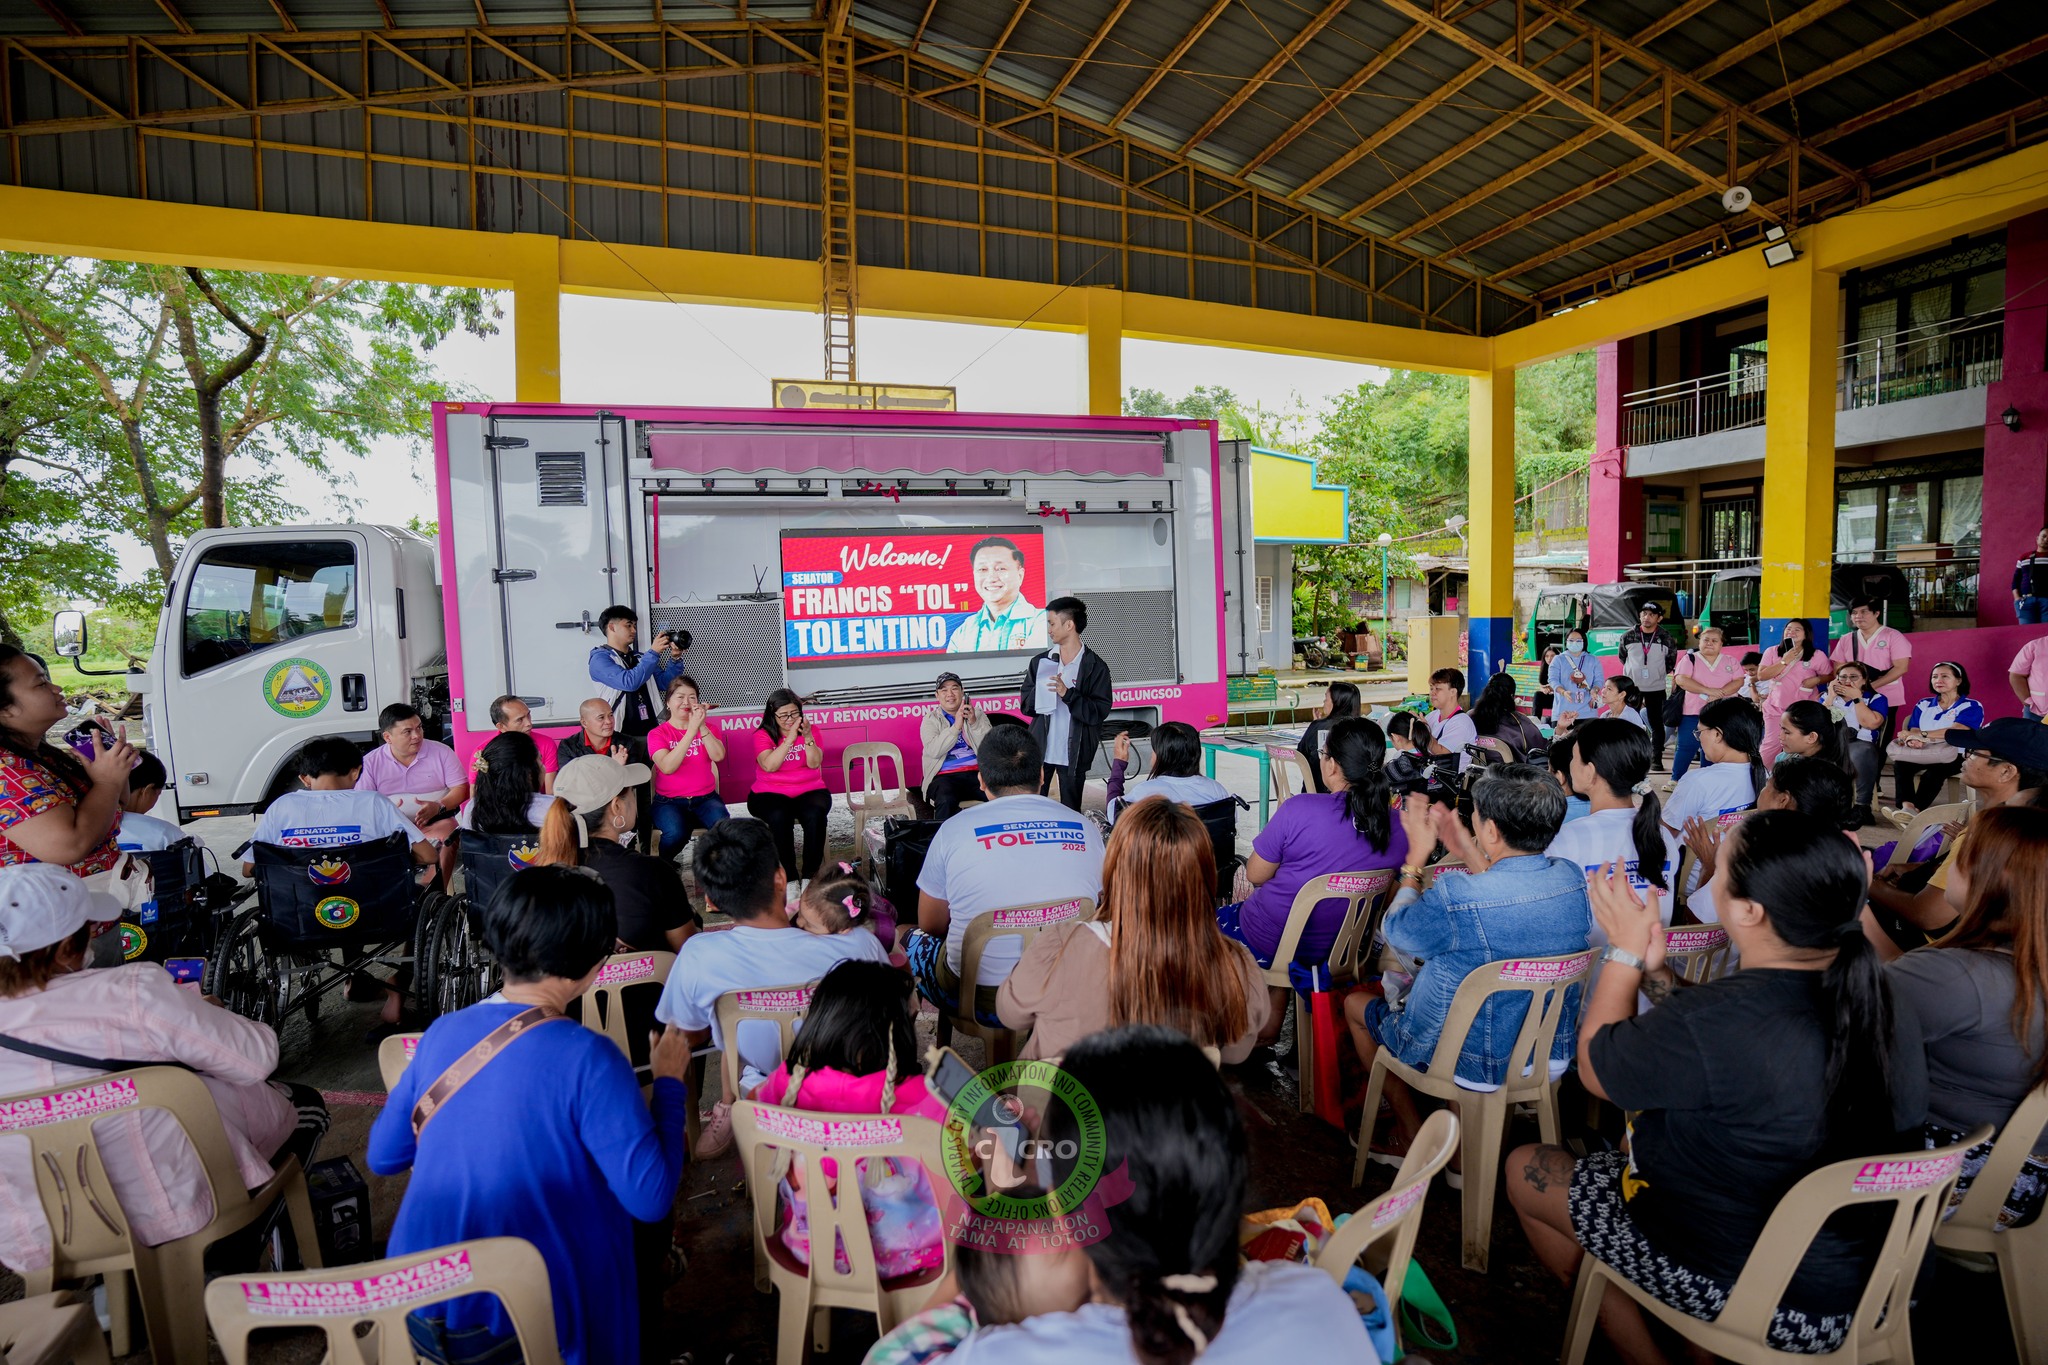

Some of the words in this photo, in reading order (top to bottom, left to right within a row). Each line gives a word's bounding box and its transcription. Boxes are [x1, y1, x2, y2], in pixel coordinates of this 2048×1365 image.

[840, 540, 952, 574] Welcome!
[791, 572, 834, 585] SENATOR
[792, 585, 892, 616] FRANCIS
[899, 583, 969, 611] “TOL”
[793, 615, 947, 656] TOLENTINO
[721, 716, 763, 731] MAYO
[833, 704, 938, 723] REYNOSO-PONT
[1112, 687, 1182, 702] NGLUNGSOD
[293, 827, 338, 835] SENATOR
[1002, 821, 1059, 831] SENATOR
[976, 831, 1085, 850] TOLENTINO
[1061, 843, 1087, 852] 2025
[1338, 876, 1371, 884] MAYOR
[1004, 907, 1080, 924] REYNOSO-PONTIOSO
[1006, 909, 1044, 918] MAYOR
[1046, 900, 1080, 915] LOVELY
[1672, 932, 1709, 940] MAYOR
[604, 957, 652, 973] LOVELY
[1518, 962, 1560, 970] MAYOR
[751, 991, 798, 999] MAYOR
[48, 1078, 132, 1106] LOVELY
[0, 1088, 136, 1123] NOSO-PONTIOSO
[19, 1116, 58, 1128] ASENSO
[61, 1112, 74, 1120] AT
[768, 1111, 825, 1131] MAYOR
[829, 1118, 899, 1132] LOVELY
[769, 1119, 902, 1141] REYNOSO-PONTIOSO
[268, 1281, 355, 1297] MAYOR
[363, 1250, 465, 1292] LOVELY
[269, 1262, 470, 1307] REYNOSO-PONTIOSO
